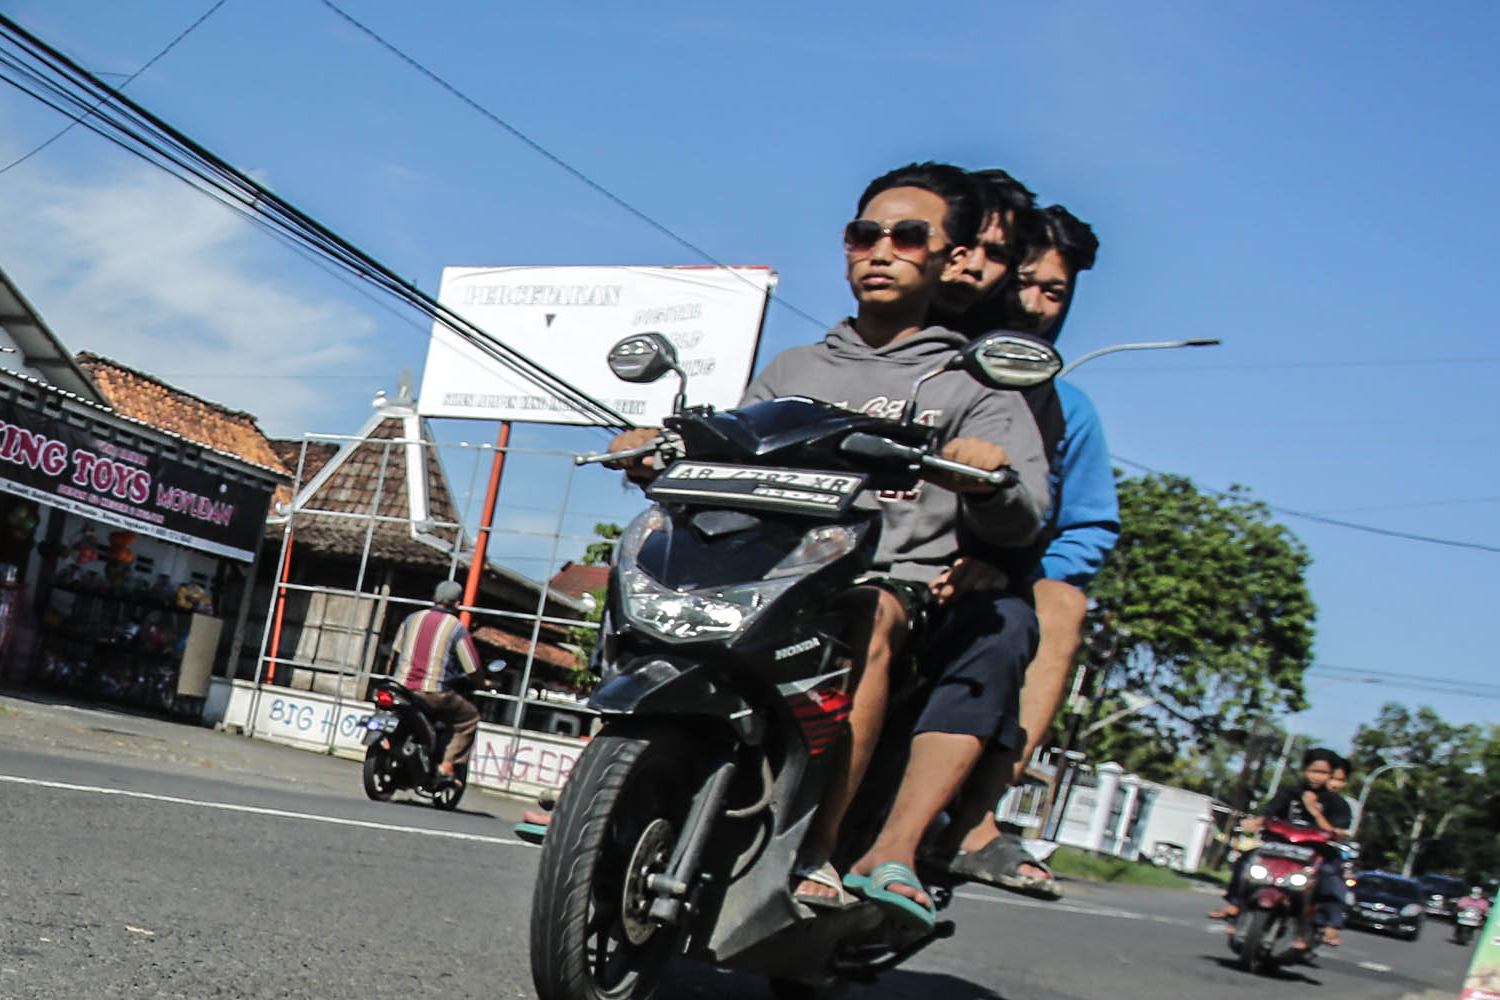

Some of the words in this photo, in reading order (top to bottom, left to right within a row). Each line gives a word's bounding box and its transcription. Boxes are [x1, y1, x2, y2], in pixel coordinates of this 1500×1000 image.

[72, 448, 150, 504] TOYS
[775, 637, 821, 660] HONDA
[268, 698, 314, 733] BIG
